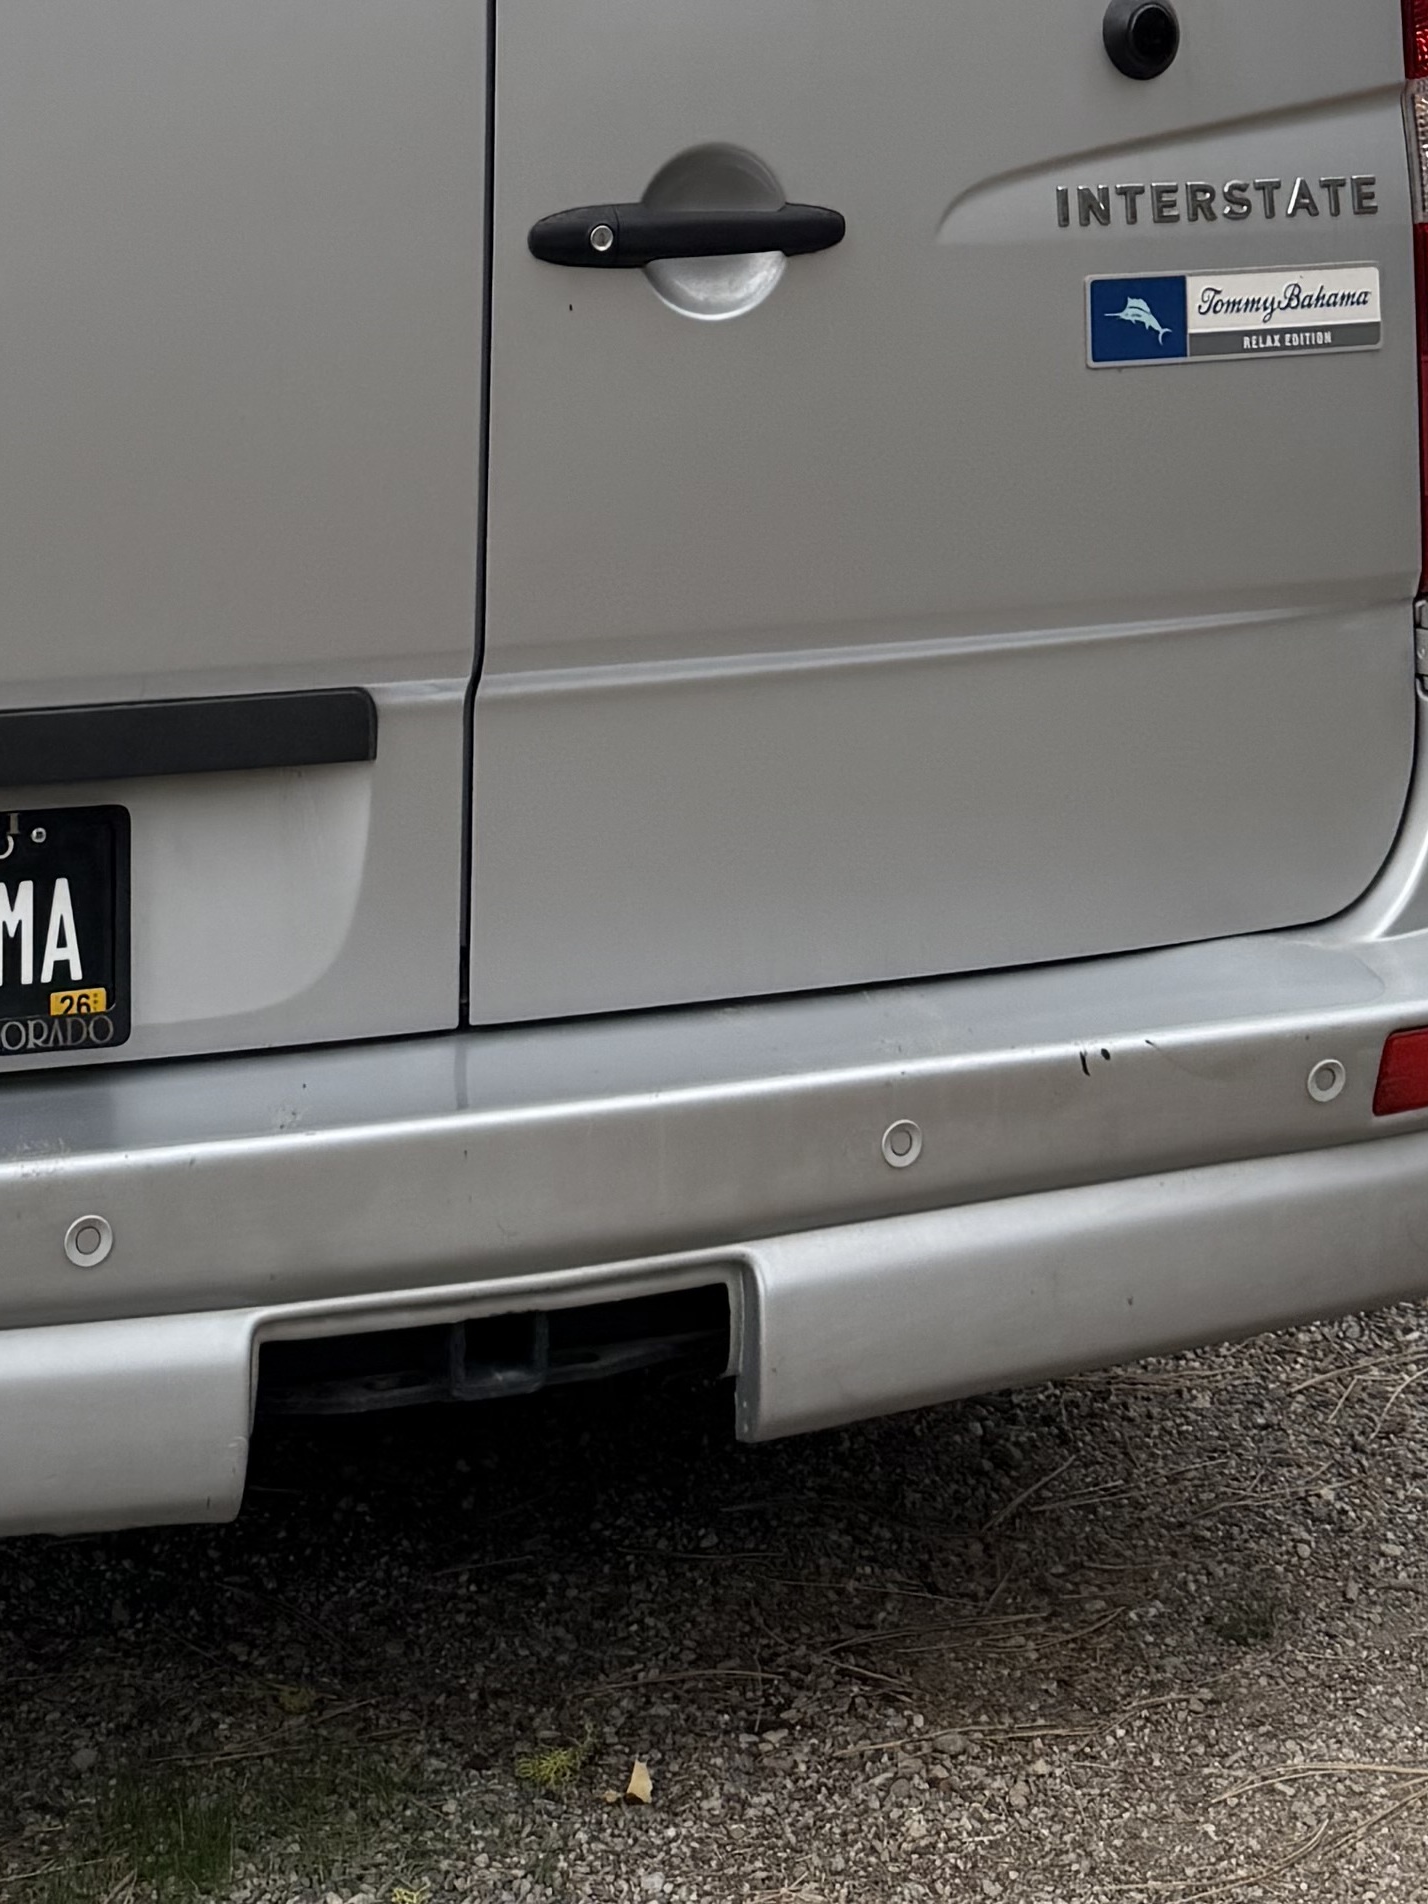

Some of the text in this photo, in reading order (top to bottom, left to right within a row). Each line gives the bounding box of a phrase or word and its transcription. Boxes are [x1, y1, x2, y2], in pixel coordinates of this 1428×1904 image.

[1056, 175, 1378, 228] INTERSTATE
[1198, 283, 1371, 323] Tommy Bahama
[1243, 331, 1332, 349] RELAX EDITION
[60, 993, 91, 1015] 26
